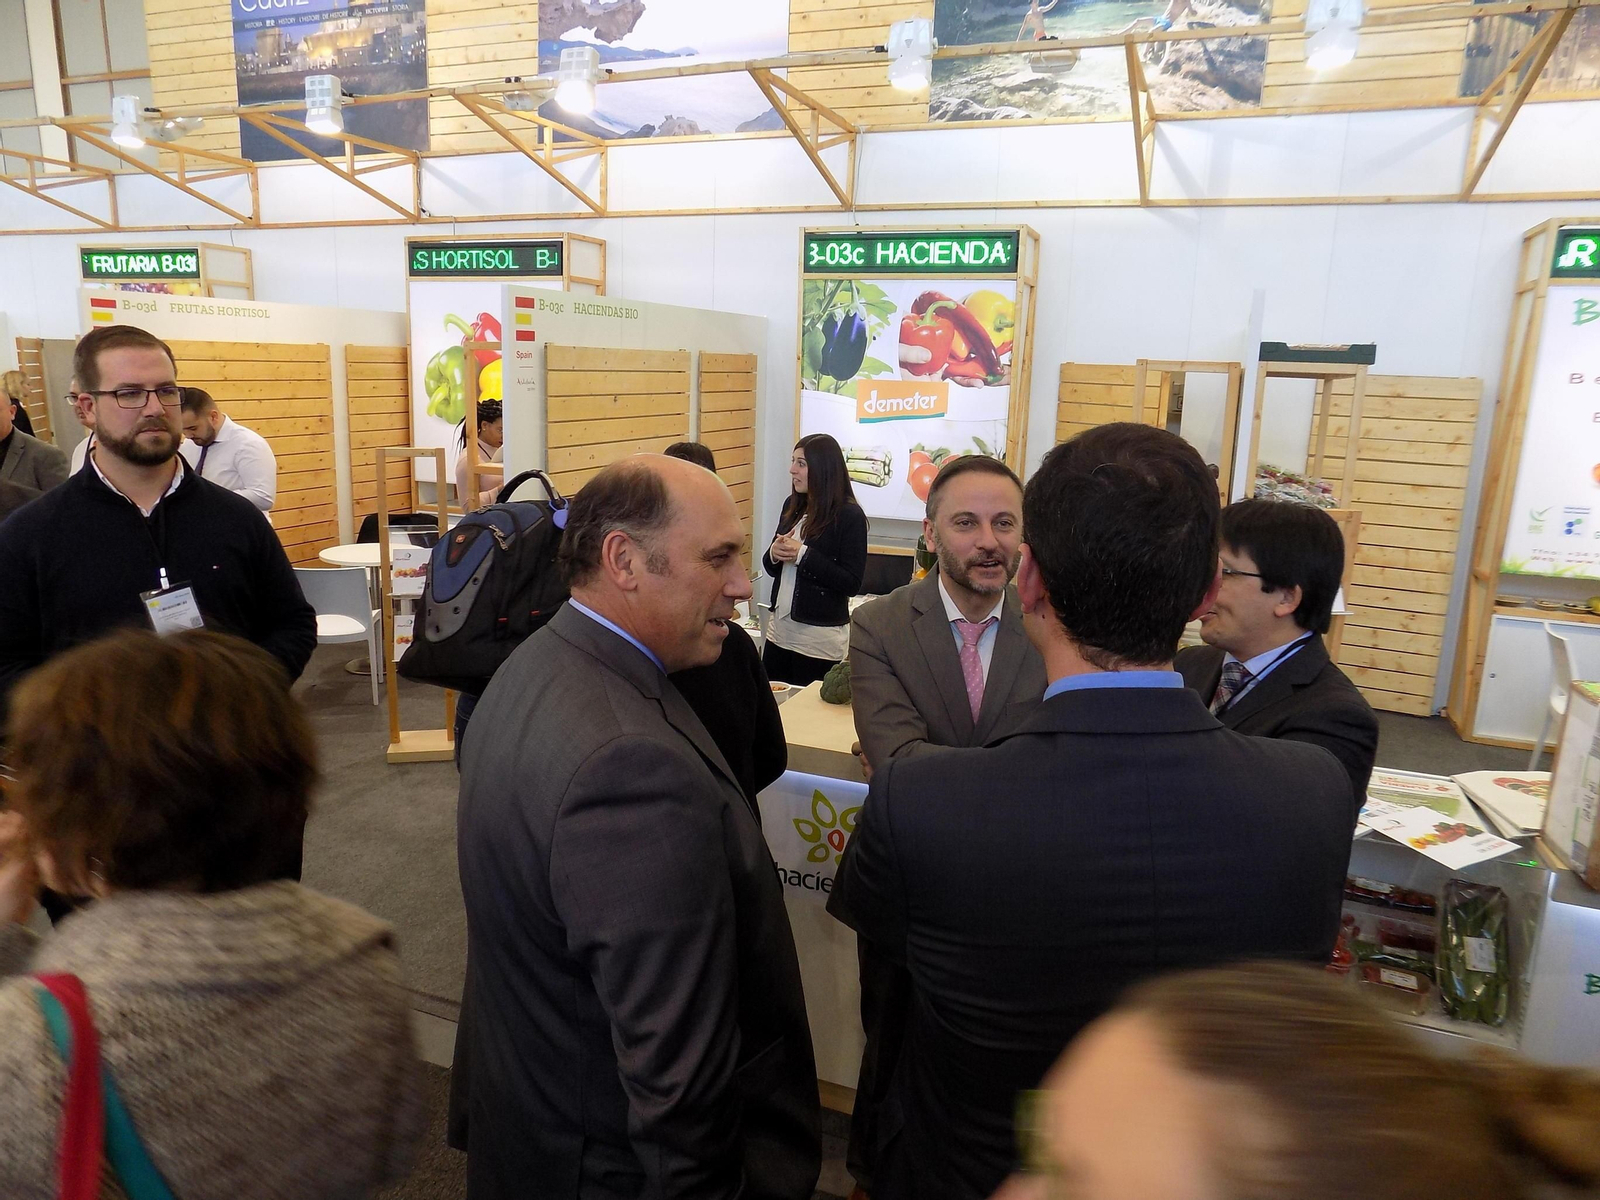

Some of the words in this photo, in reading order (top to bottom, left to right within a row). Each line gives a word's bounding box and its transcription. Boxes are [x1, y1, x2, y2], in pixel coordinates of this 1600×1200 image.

[432, 249, 519, 270] HORTISOL
[876, 240, 1011, 265] HACIENDA
[92, 254, 160, 273] FRUTARIA
[122, 300, 157, 312] B-03d
[169, 302, 214, 314] FRUTAS
[217, 306, 270, 318] HORTISOL
[539, 299, 564, 314] B-03c
[573, 302, 623, 318] HACIENDAS
[624, 307, 639, 320] BIO
[516, 350, 533, 360] Spain
[863, 390, 937, 413] demeter
